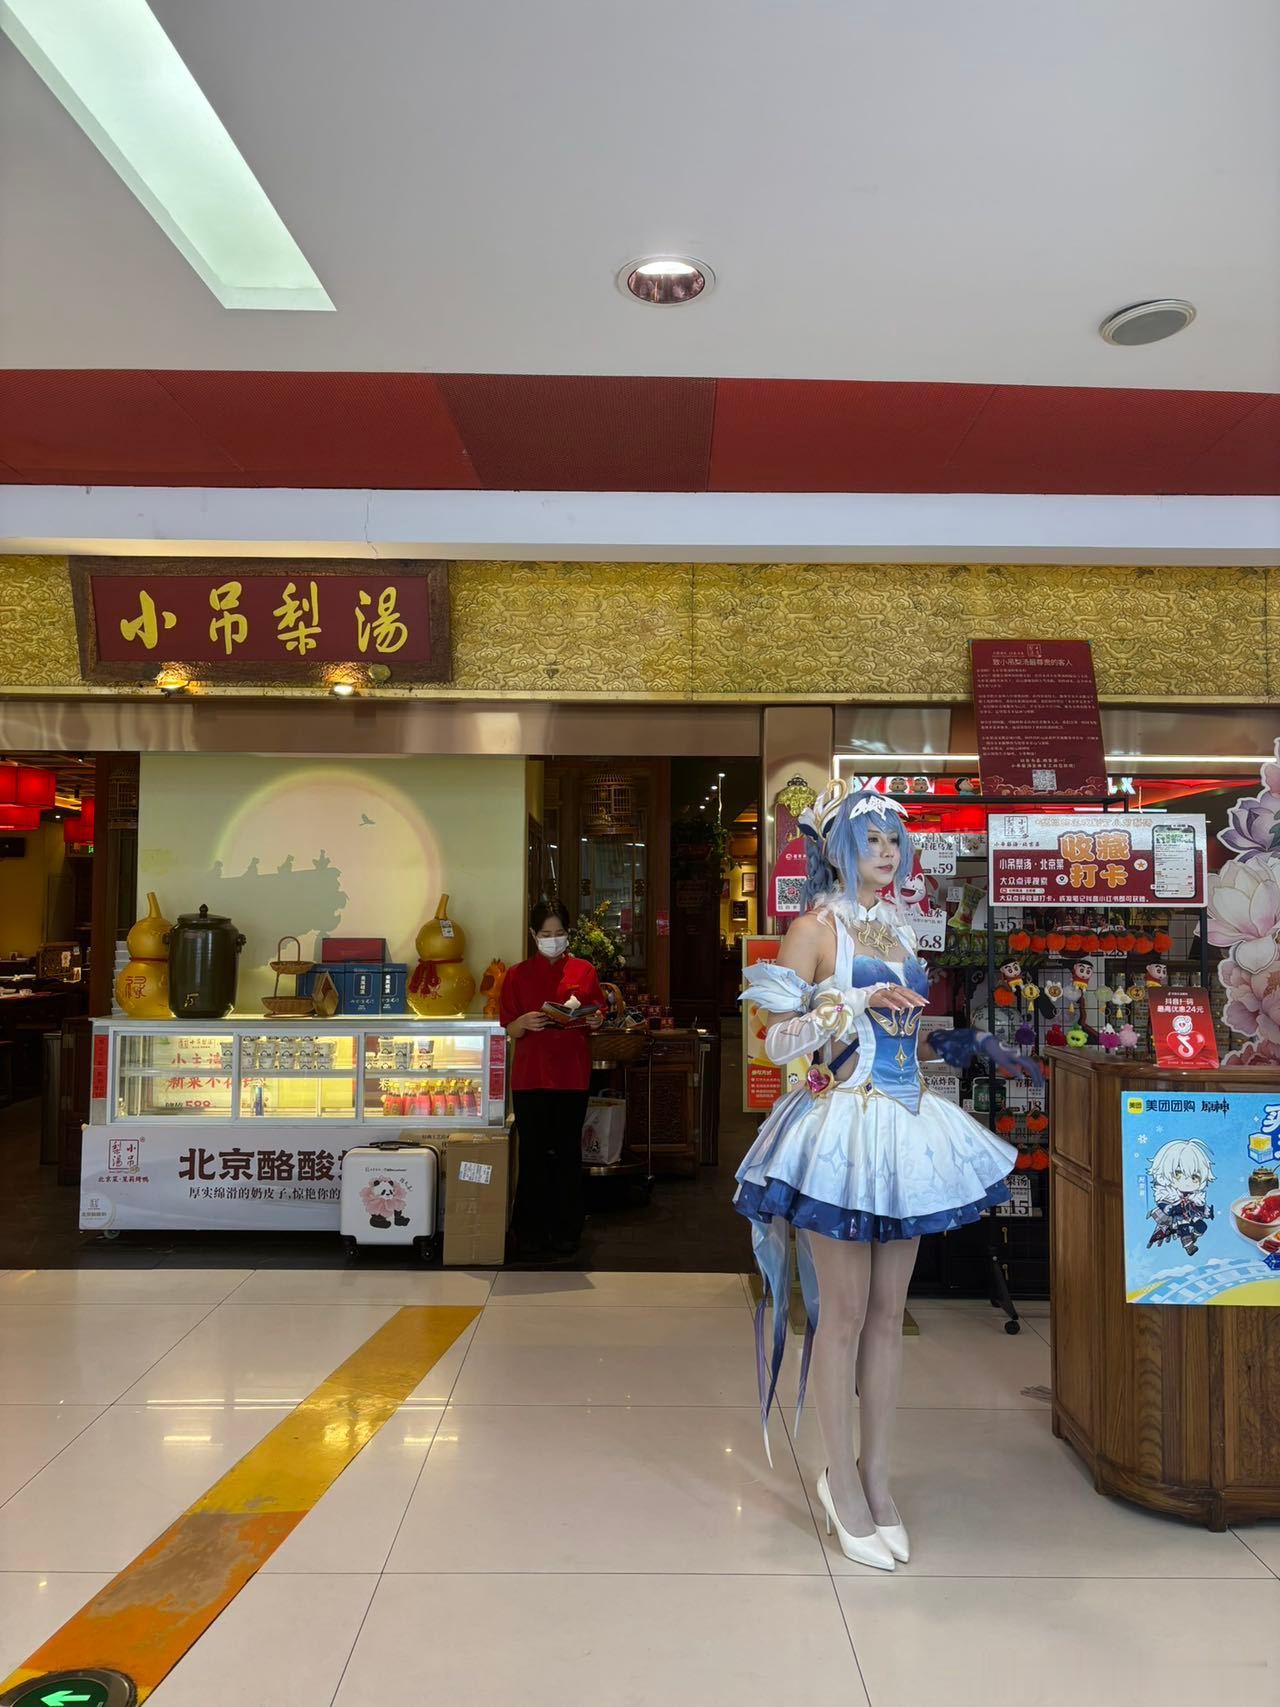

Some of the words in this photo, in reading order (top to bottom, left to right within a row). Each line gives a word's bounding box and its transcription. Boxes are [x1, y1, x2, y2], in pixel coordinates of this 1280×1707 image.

[1060, 831, 1131, 862] 收藏
[1069, 863, 1128, 888] 打卡
[1146, 1100, 1196, 1112] 美团团购
